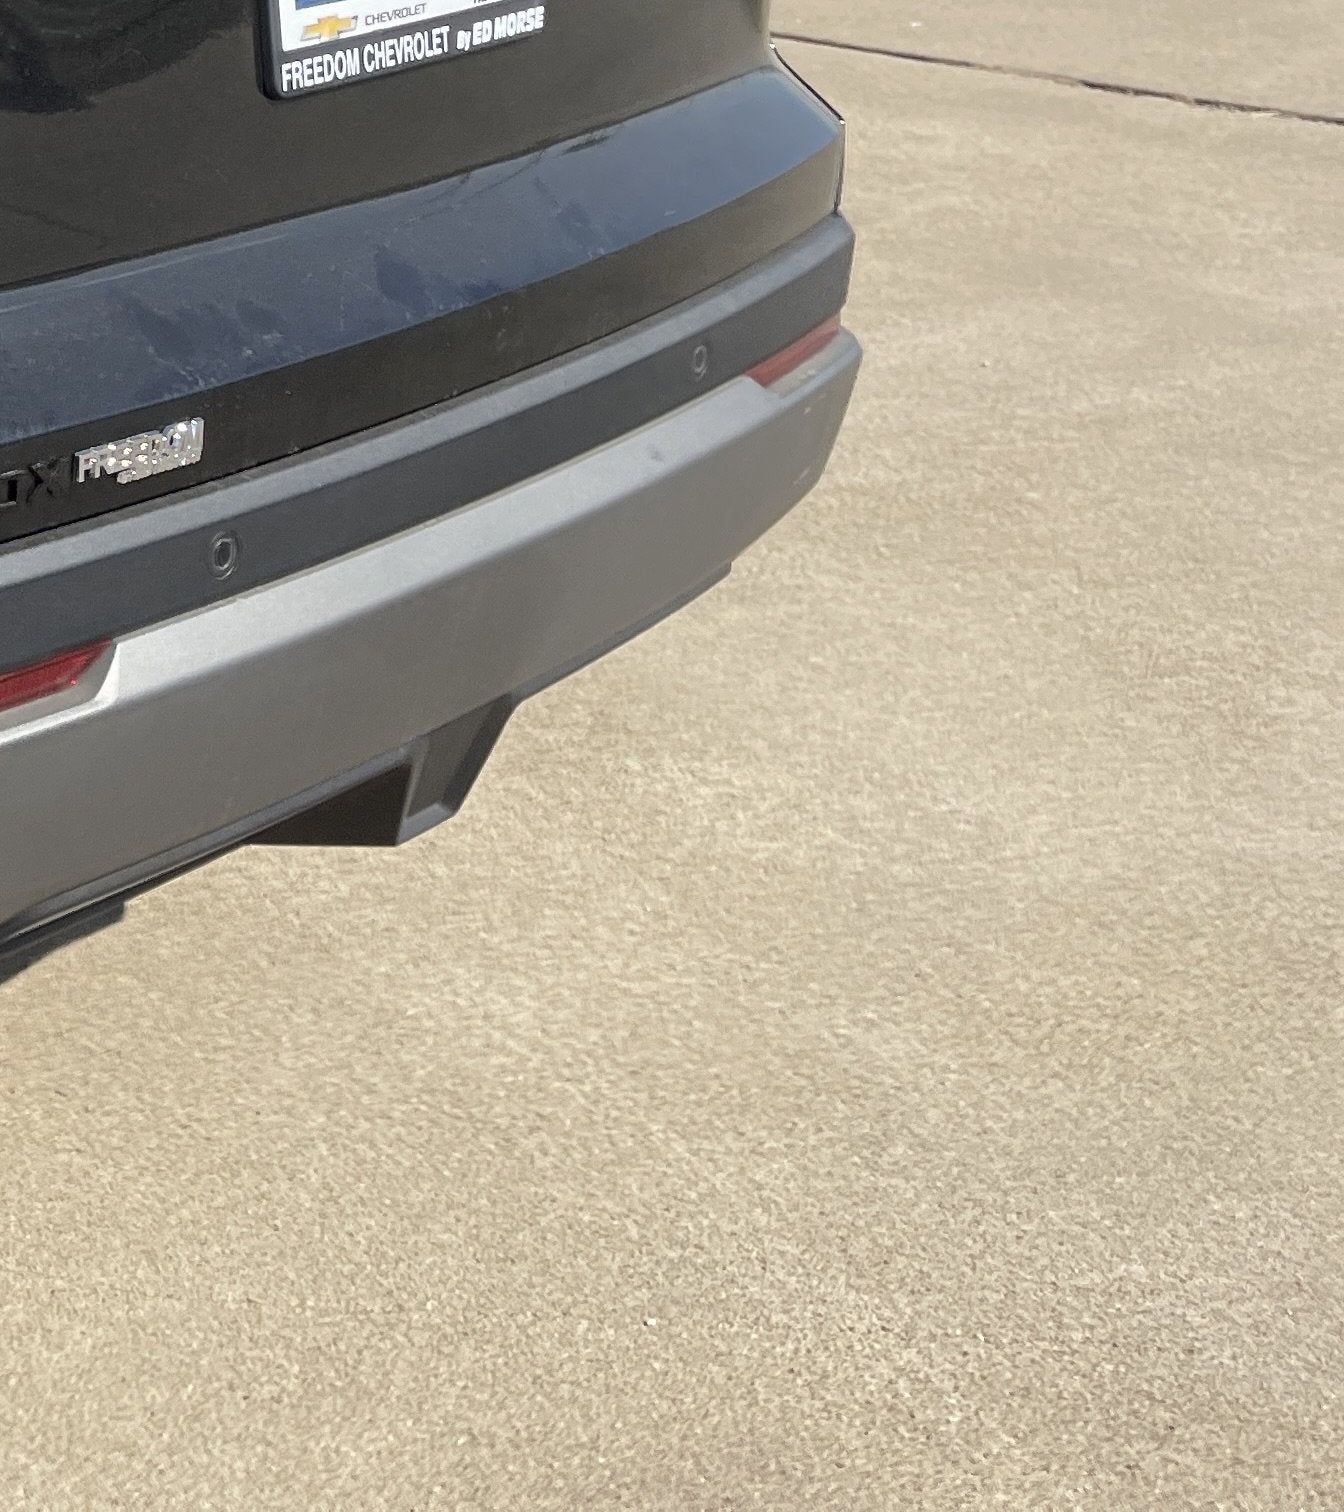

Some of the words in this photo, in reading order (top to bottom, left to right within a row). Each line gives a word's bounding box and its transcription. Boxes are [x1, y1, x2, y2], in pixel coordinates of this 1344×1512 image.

[365, 2, 428, 26] CHEVROLET
[281, 48, 361, 92] FREEDOM
[363, 25, 450, 73] CHEVROLET
[472, 21, 493, 46] ED
[493, 6, 545, 40] MORSE
